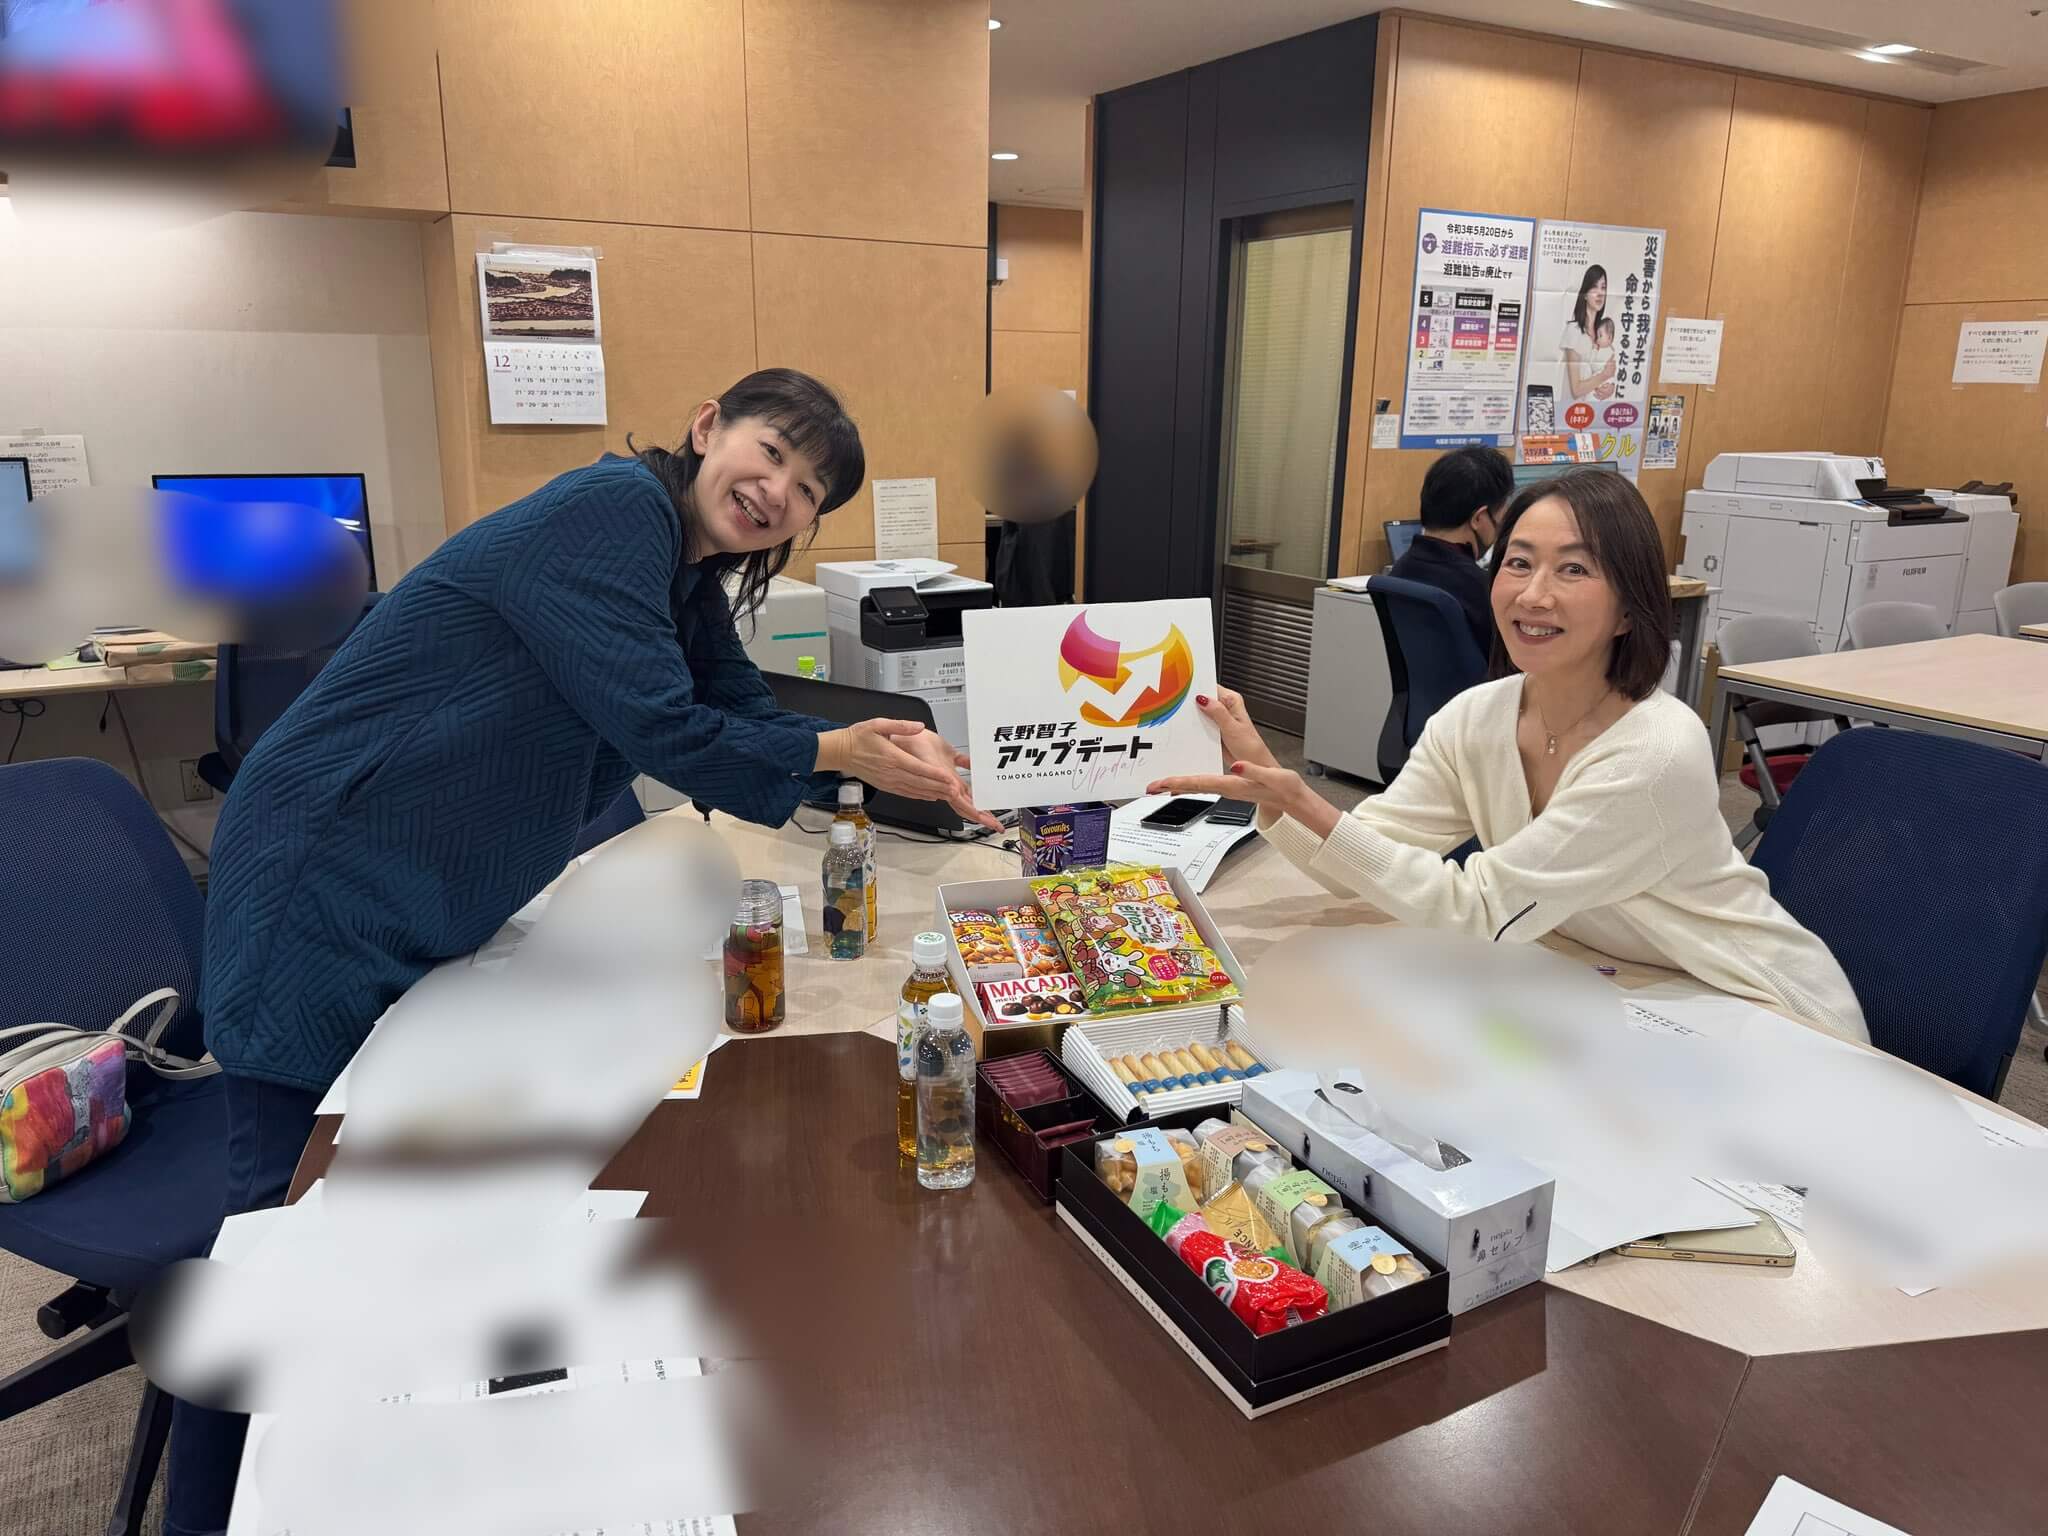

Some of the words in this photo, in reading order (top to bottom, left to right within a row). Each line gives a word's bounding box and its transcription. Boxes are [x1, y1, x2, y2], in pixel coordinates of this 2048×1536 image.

[1447, 223, 1514, 238] 令和3年5月20日から
[1441, 240, 1528, 260] 避難指示で必ず避難
[1443, 263, 1512, 279] 避難勧告は廃止です
[1631, 236, 1658, 385] 災害から我が子の
[1615, 273, 1639, 398] 命を守るために
[494, 354, 511, 368] 12
[994, 722, 1078, 742] 長野智子
[996, 736, 1153, 769] アップデート
[996, 772, 1033, 781] TOMOKO
[1004, 911, 1048, 924] Pucca
[995, 995, 1018, 1003] meiji
[1322, 1168, 1347, 1189] nepia
[1490, 1229, 1513, 1242] nepia
